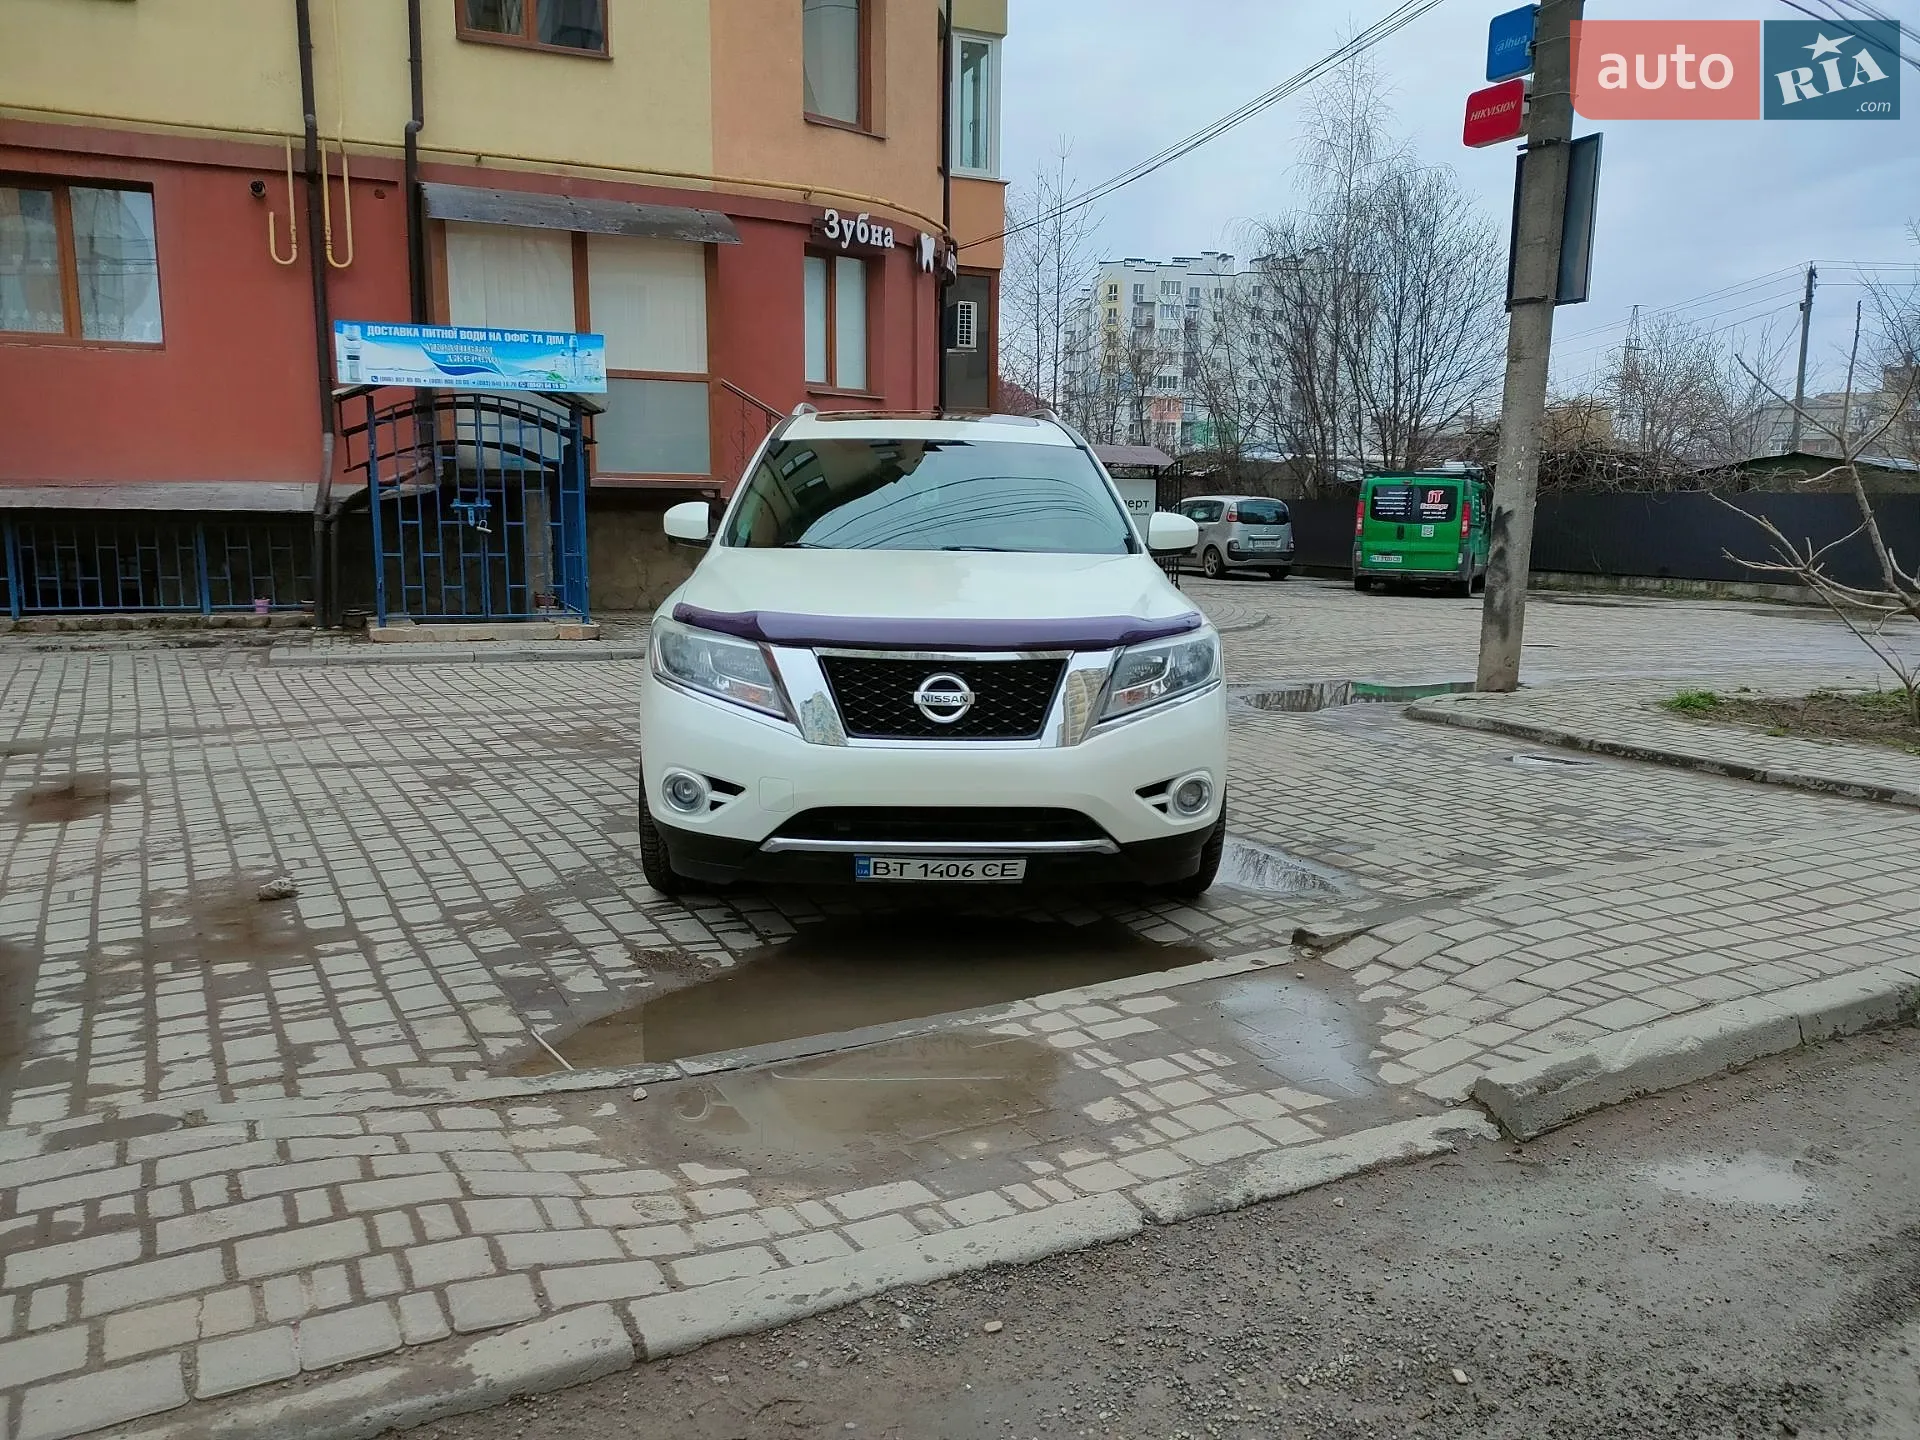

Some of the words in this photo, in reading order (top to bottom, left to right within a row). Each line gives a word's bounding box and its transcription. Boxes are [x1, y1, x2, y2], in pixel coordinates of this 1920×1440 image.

[1470, 100, 1517, 122] HIKVISION
[824, 208, 895, 249] Зубна
[367, 325, 420, 337] ДОСТАВКА
[422, 327, 458, 339] ПИТНОЇ
[460, 330, 486, 342] ВОДИ
[489, 332, 502, 342] НА
[504, 333, 529, 343] ОФІС
[532, 334, 543, 344] ТА
[546, 335, 565, 345] ДІМ
[921, 694, 969, 703] NISSAN
[872, 861, 911, 876] BT
[917, 862, 975, 878] 1406
[981, 862, 1019, 877] CE
